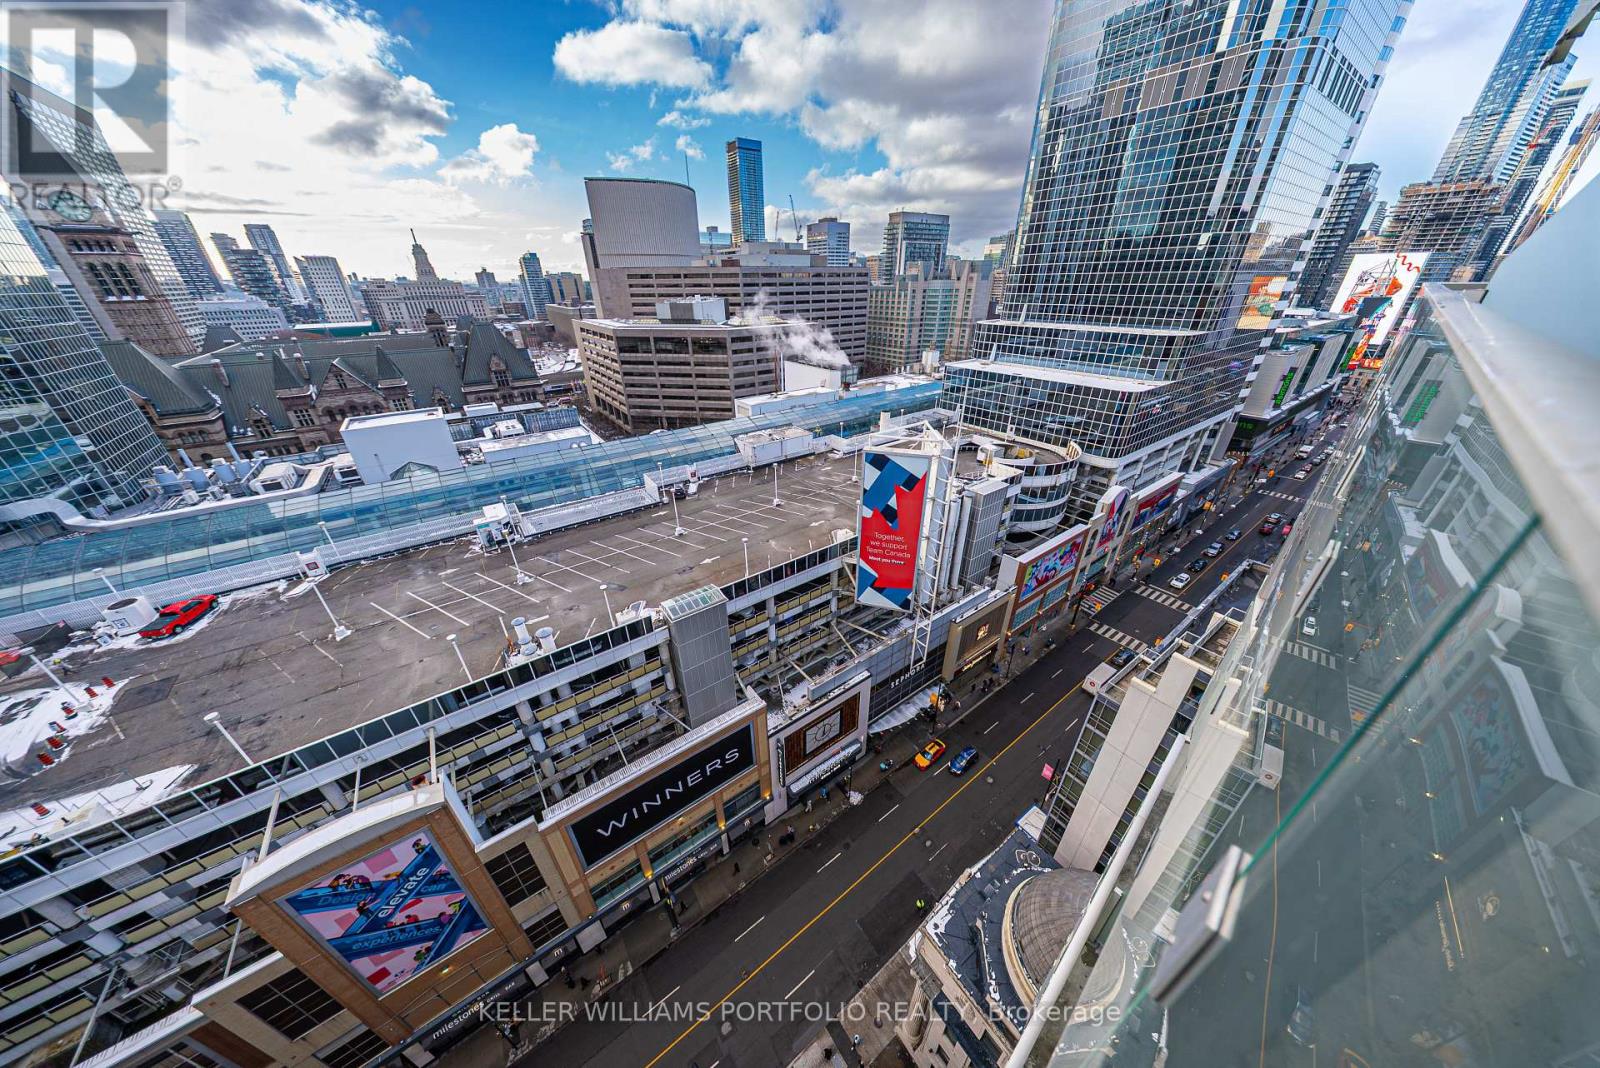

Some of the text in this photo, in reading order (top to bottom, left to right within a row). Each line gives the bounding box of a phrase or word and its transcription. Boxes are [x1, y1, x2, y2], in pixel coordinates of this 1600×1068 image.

[866, 546, 911, 558] Team Canada
[881, 541, 908, 550] support
[890, 663, 925, 688] SEPHORA
[596, 748, 740, 837] WINNERS
[378, 867, 429, 918] elevate
[420, 883, 447, 893] can
[432, 1001, 485, 1040] milestones
